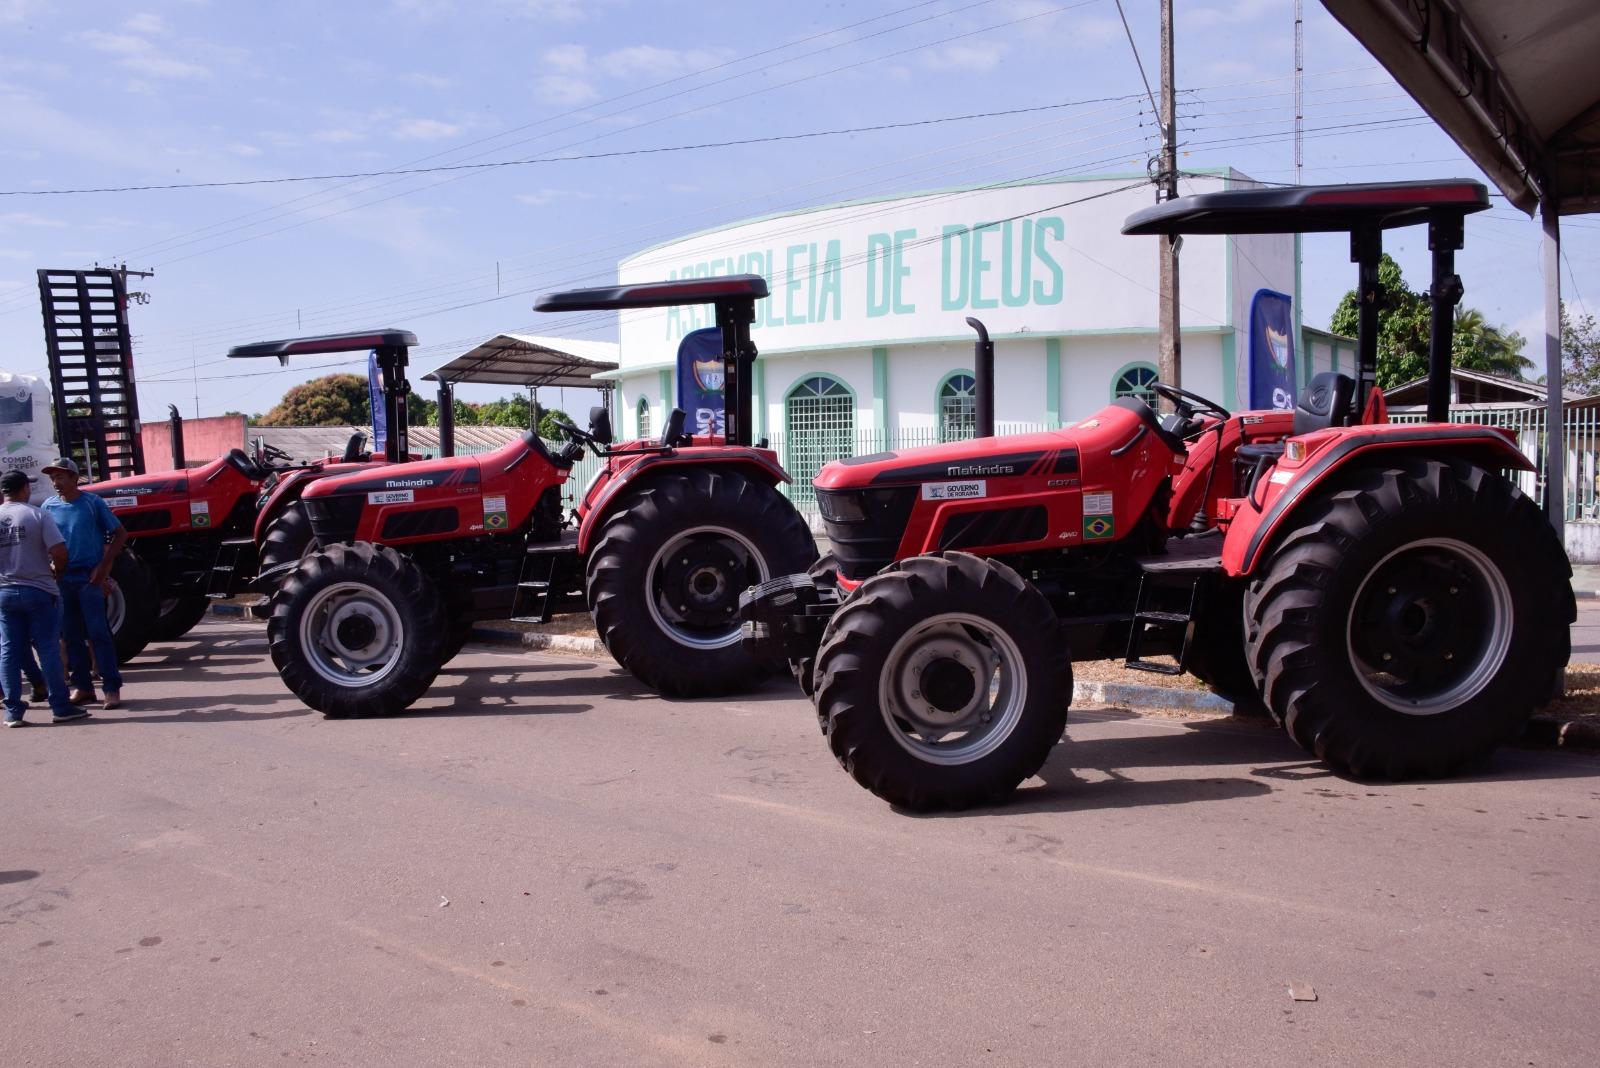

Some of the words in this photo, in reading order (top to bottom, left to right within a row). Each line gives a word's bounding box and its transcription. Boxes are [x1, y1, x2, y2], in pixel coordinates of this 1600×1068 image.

[867, 228, 917, 318] DE
[941, 216, 1065, 312] DEUS
[2, 455, 33, 464] COMPO
[8, 460, 39, 470] EXPERT
[947, 464, 1015, 476] Mahindra
[386, 479, 434, 488] Mahindra
[946, 484, 979, 492] GOVERNO
[1058, 531, 1078, 539] 4WD
